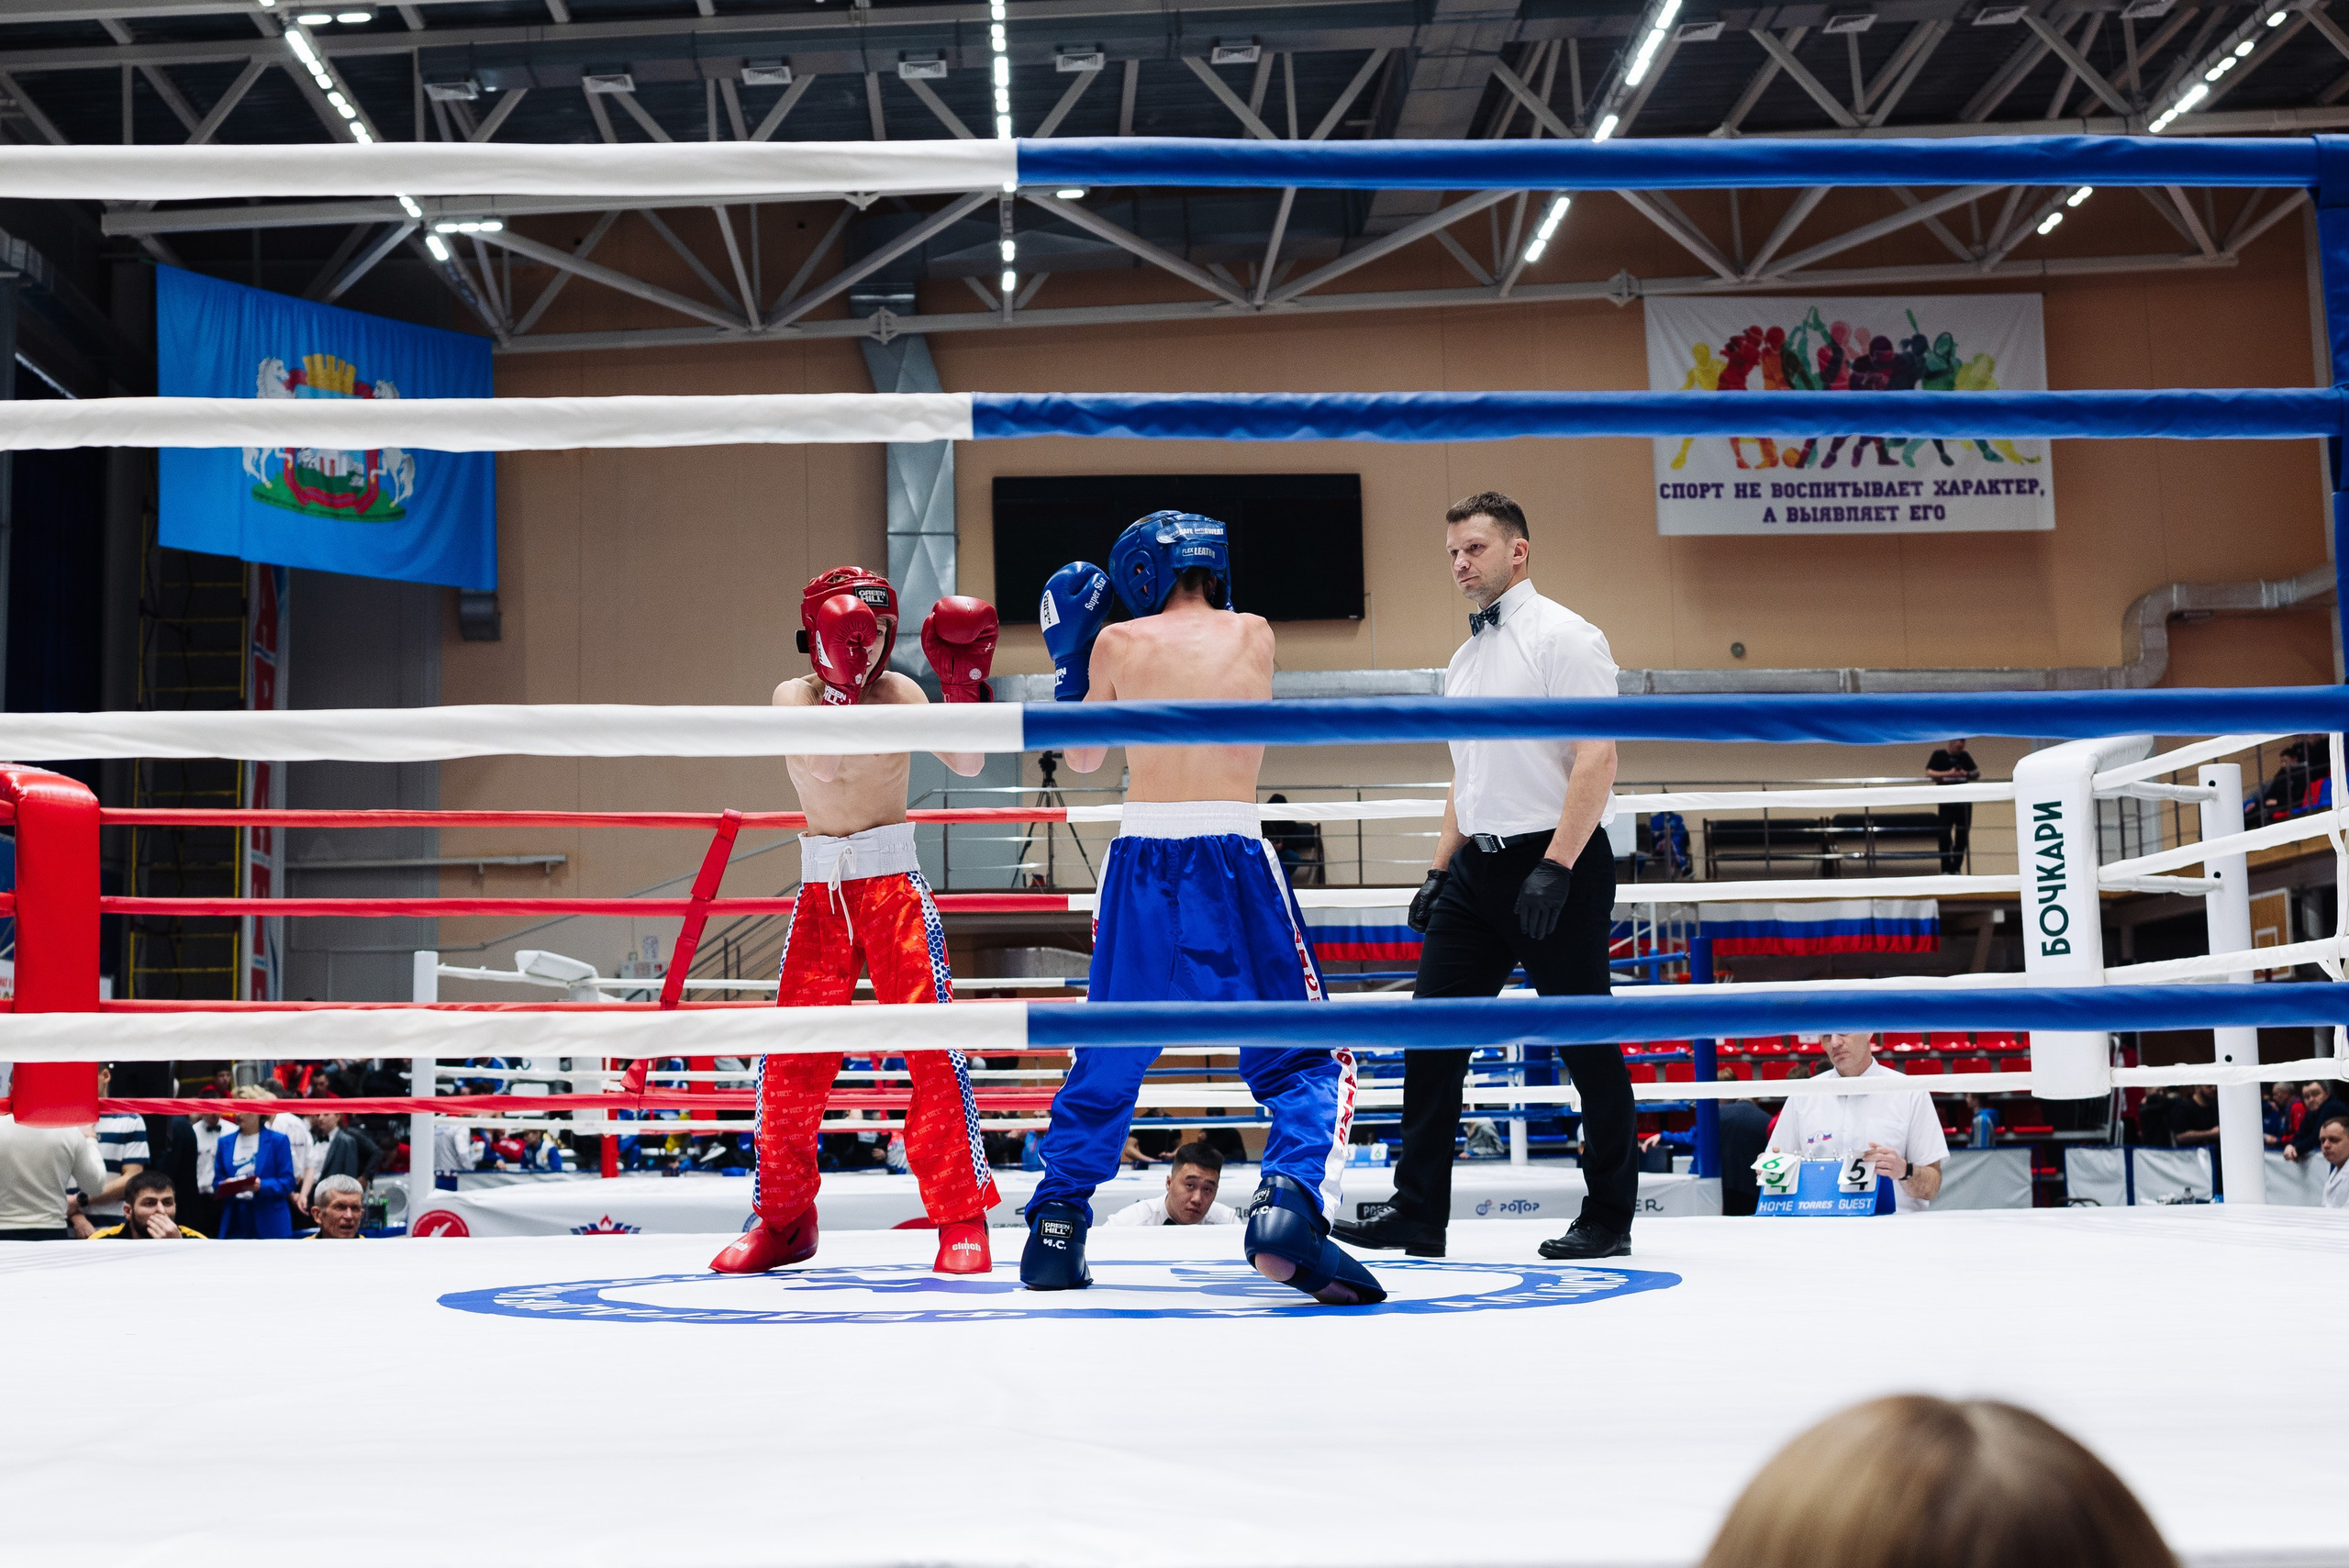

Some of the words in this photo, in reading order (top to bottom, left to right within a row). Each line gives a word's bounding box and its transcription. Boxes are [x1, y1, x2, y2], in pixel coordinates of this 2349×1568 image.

[1660, 483, 1724, 499] СПОРТ
[1734, 482, 1762, 498] НЕ
[1771, 480, 1923, 498] ВОСПИТЫВАЕТ
[1933, 477, 2045, 499] ХАРАКТЕР,
[1763, 507, 1777, 523] А
[1787, 505, 1900, 523] ВЫЯВЛЯЕТ
[1909, 504, 1946, 522] ЕГО
[1085, 590, 1101, 611] Super
[1094, 577, 1107, 592] Star
[2032, 800, 2071, 957] БОЧКАРИ
[1762, 1156, 1784, 1170] 6
[1847, 1158, 1866, 1182] 5
[1758, 1200, 1794, 1212] HOME
[1798, 1200, 1834, 1209] TORRES
[1838, 1198, 1875, 1210] GUEST
[1044, 1221, 1071, 1230] GREEN
[952, 1240, 982, 1253] clinch
